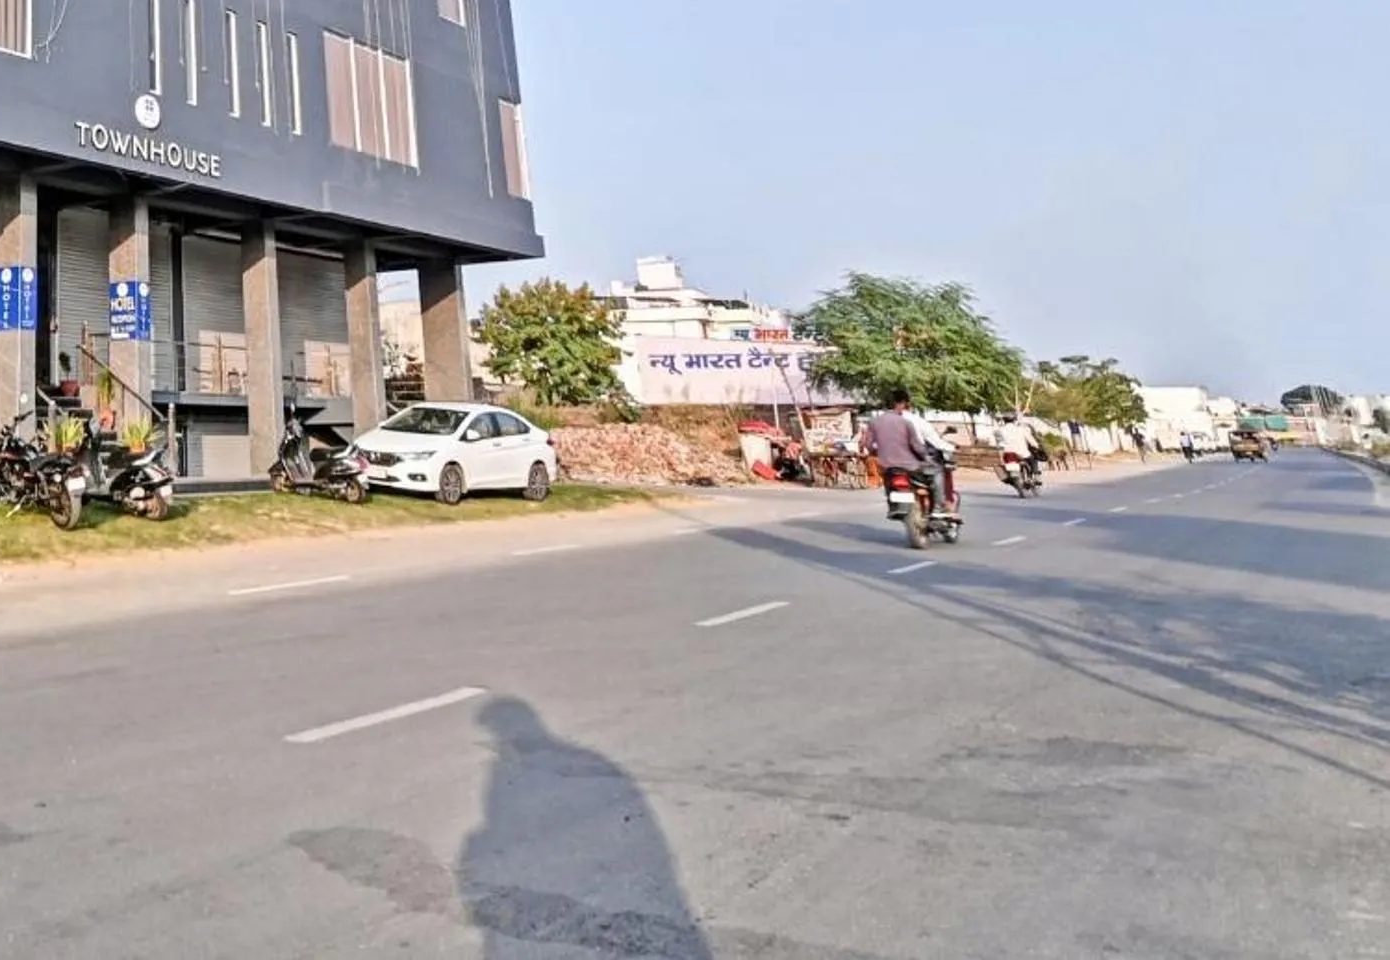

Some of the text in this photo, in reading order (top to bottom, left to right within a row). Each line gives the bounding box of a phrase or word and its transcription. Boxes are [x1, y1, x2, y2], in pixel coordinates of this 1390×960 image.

[75, 121, 221, 176] TOWNHOUSE
[110, 296, 135, 312] HOTEL
[648, 354, 682, 375] न्यू
[683, 353, 742, 370] भारत
